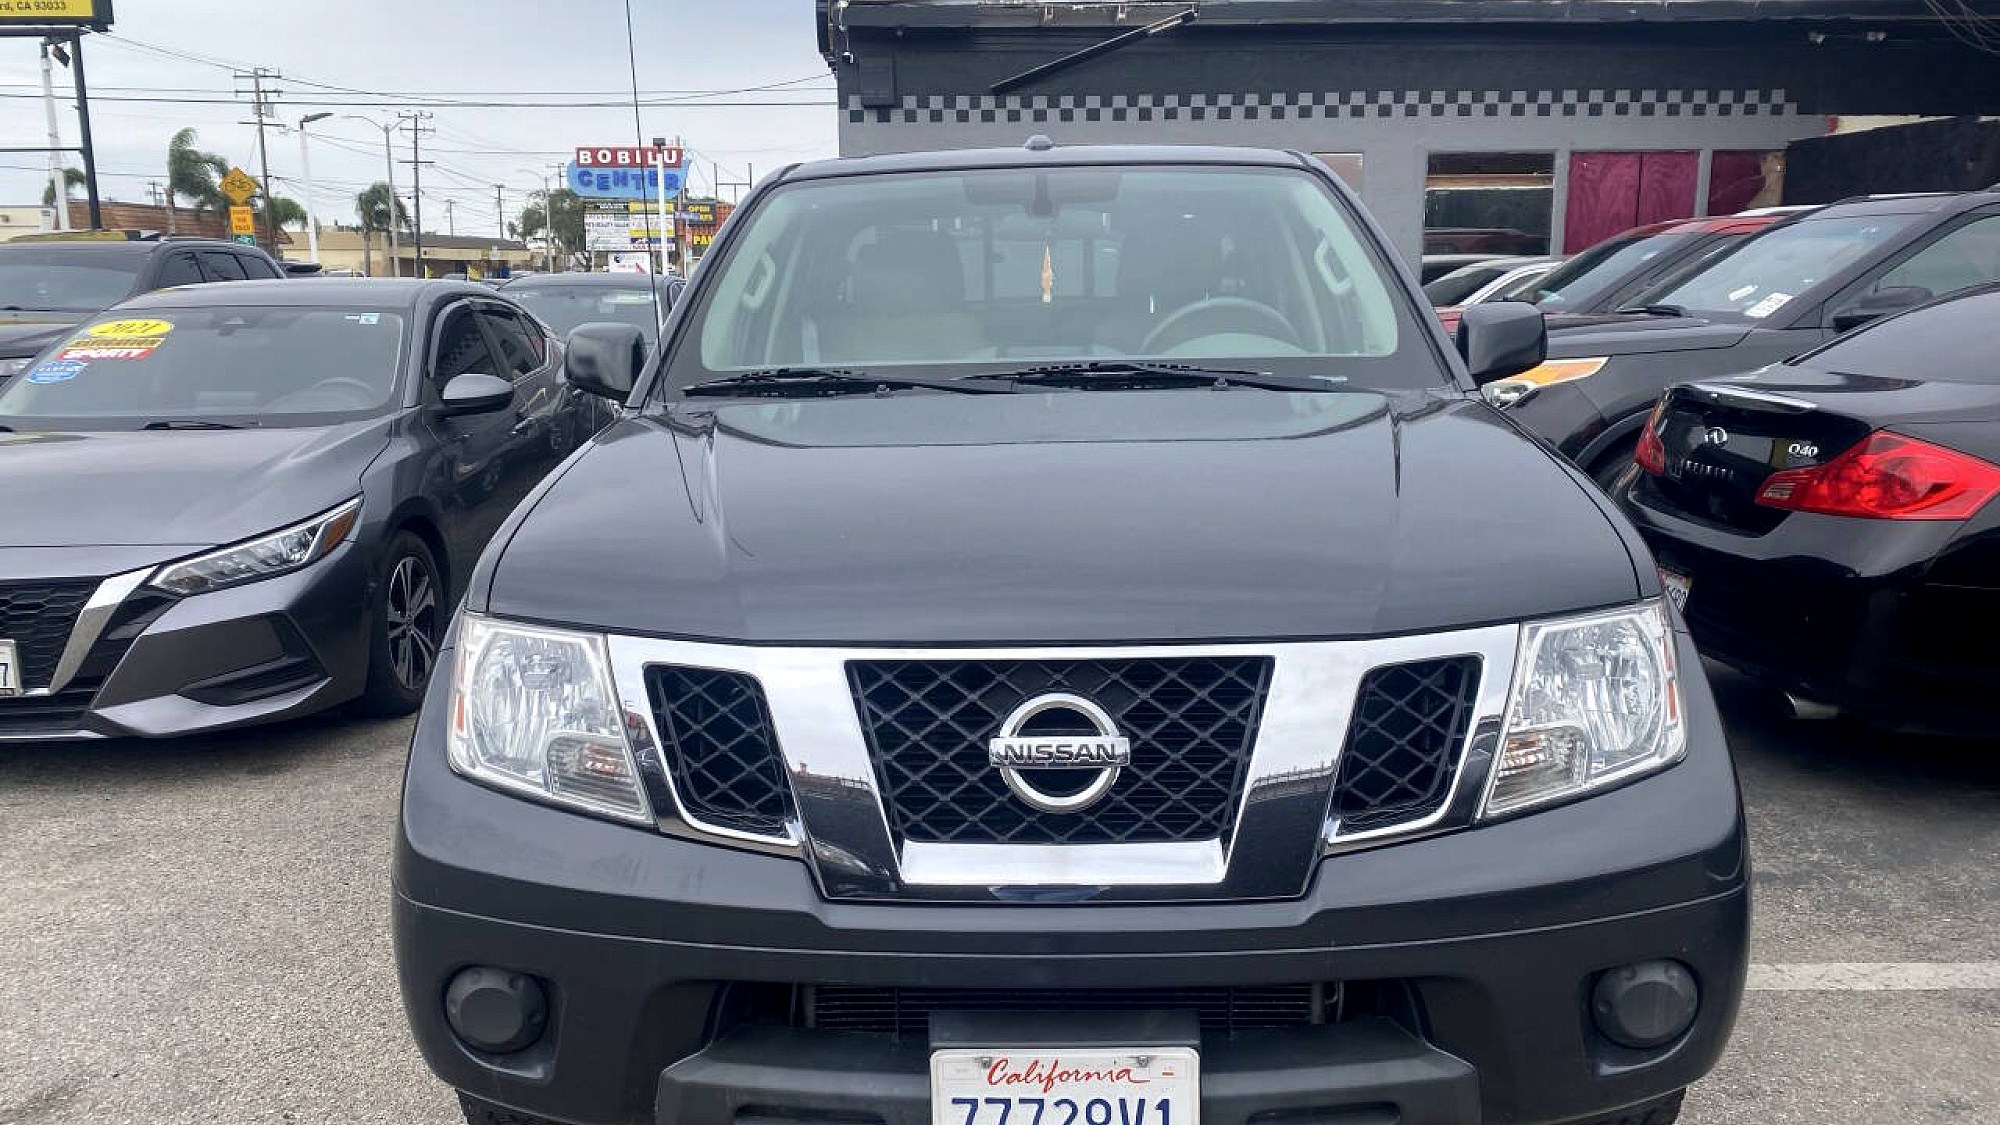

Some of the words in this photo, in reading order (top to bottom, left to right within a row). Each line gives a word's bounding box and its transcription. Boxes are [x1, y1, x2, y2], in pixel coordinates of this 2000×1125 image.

[17, 2, 31, 11] CA
[34, 2, 66, 11] 93033
[579, 149, 677, 164] BOBILU
[577, 170, 680, 190] CENTER
[1788, 443, 1819, 458] Q40
[1004, 743, 1115, 761] NISSAN
[986, 1057, 1151, 1093] California
